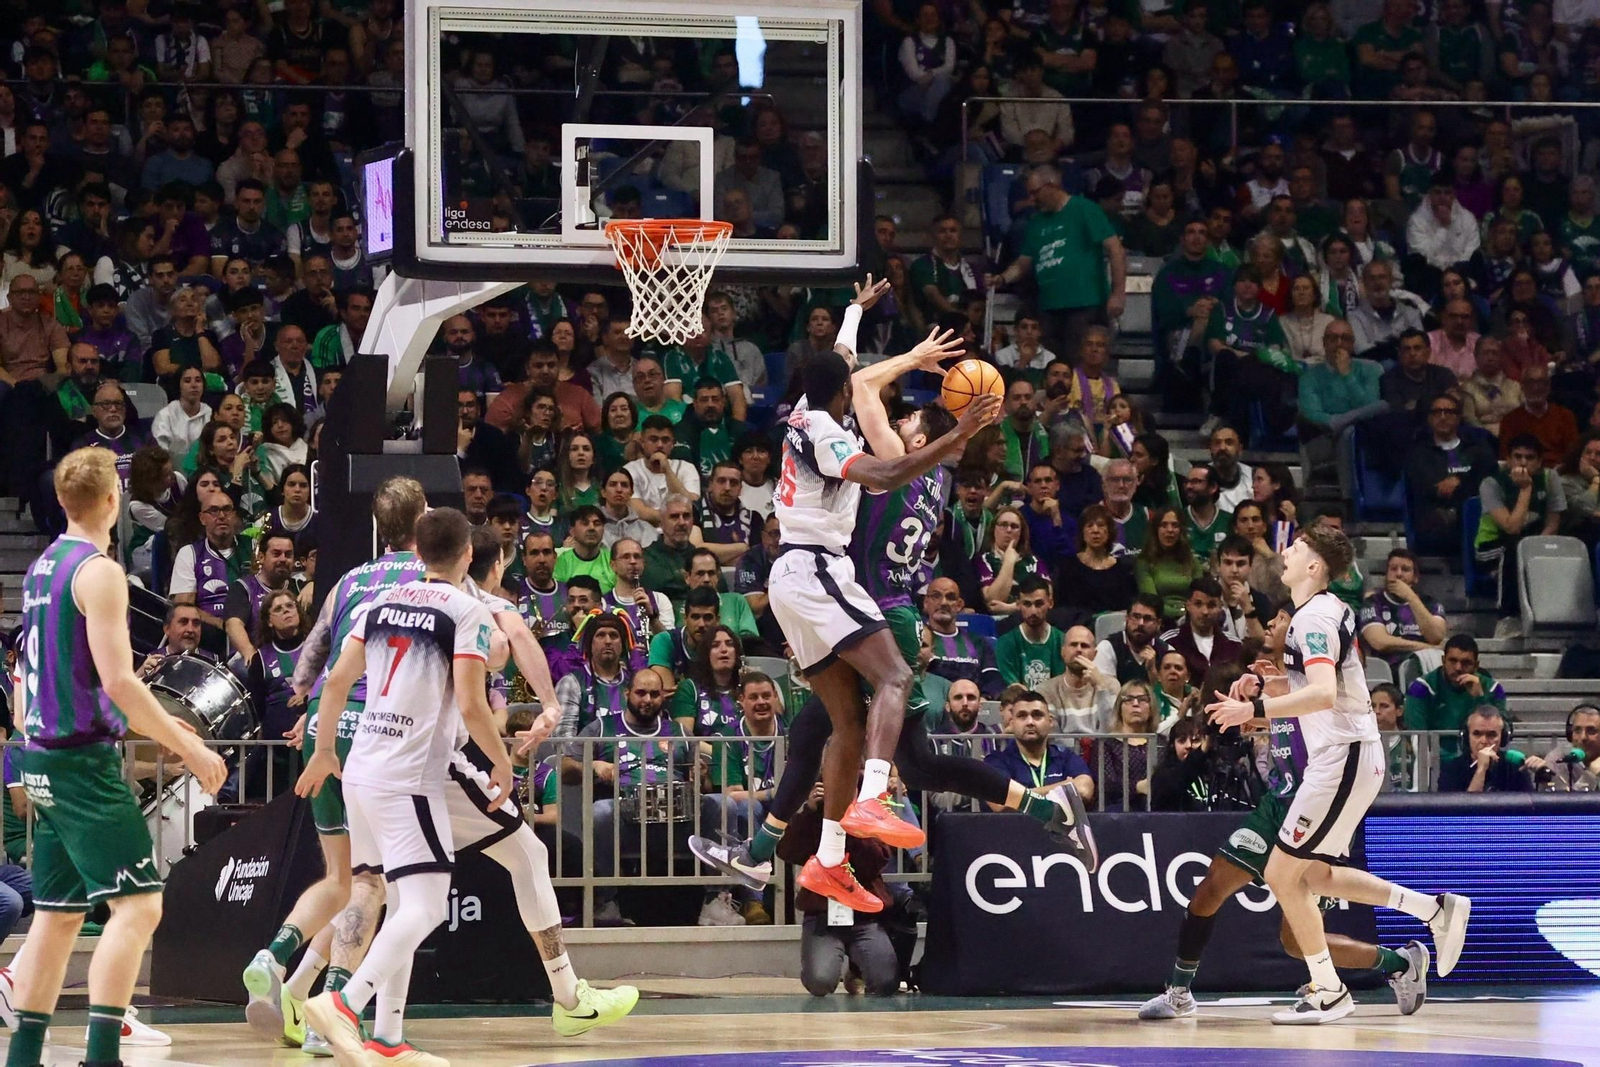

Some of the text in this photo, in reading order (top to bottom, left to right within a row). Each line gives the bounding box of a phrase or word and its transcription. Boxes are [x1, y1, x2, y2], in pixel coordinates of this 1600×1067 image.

[445, 206, 466, 220] liga
[445, 218, 491, 230] endesa
[377, 607, 436, 631] PULEVA
[380, 636, 414, 697] 7
[233, 855, 270, 880] Fundación
[964, 832, 1350, 915] ende
[228, 879, 255, 907] Unicaja
